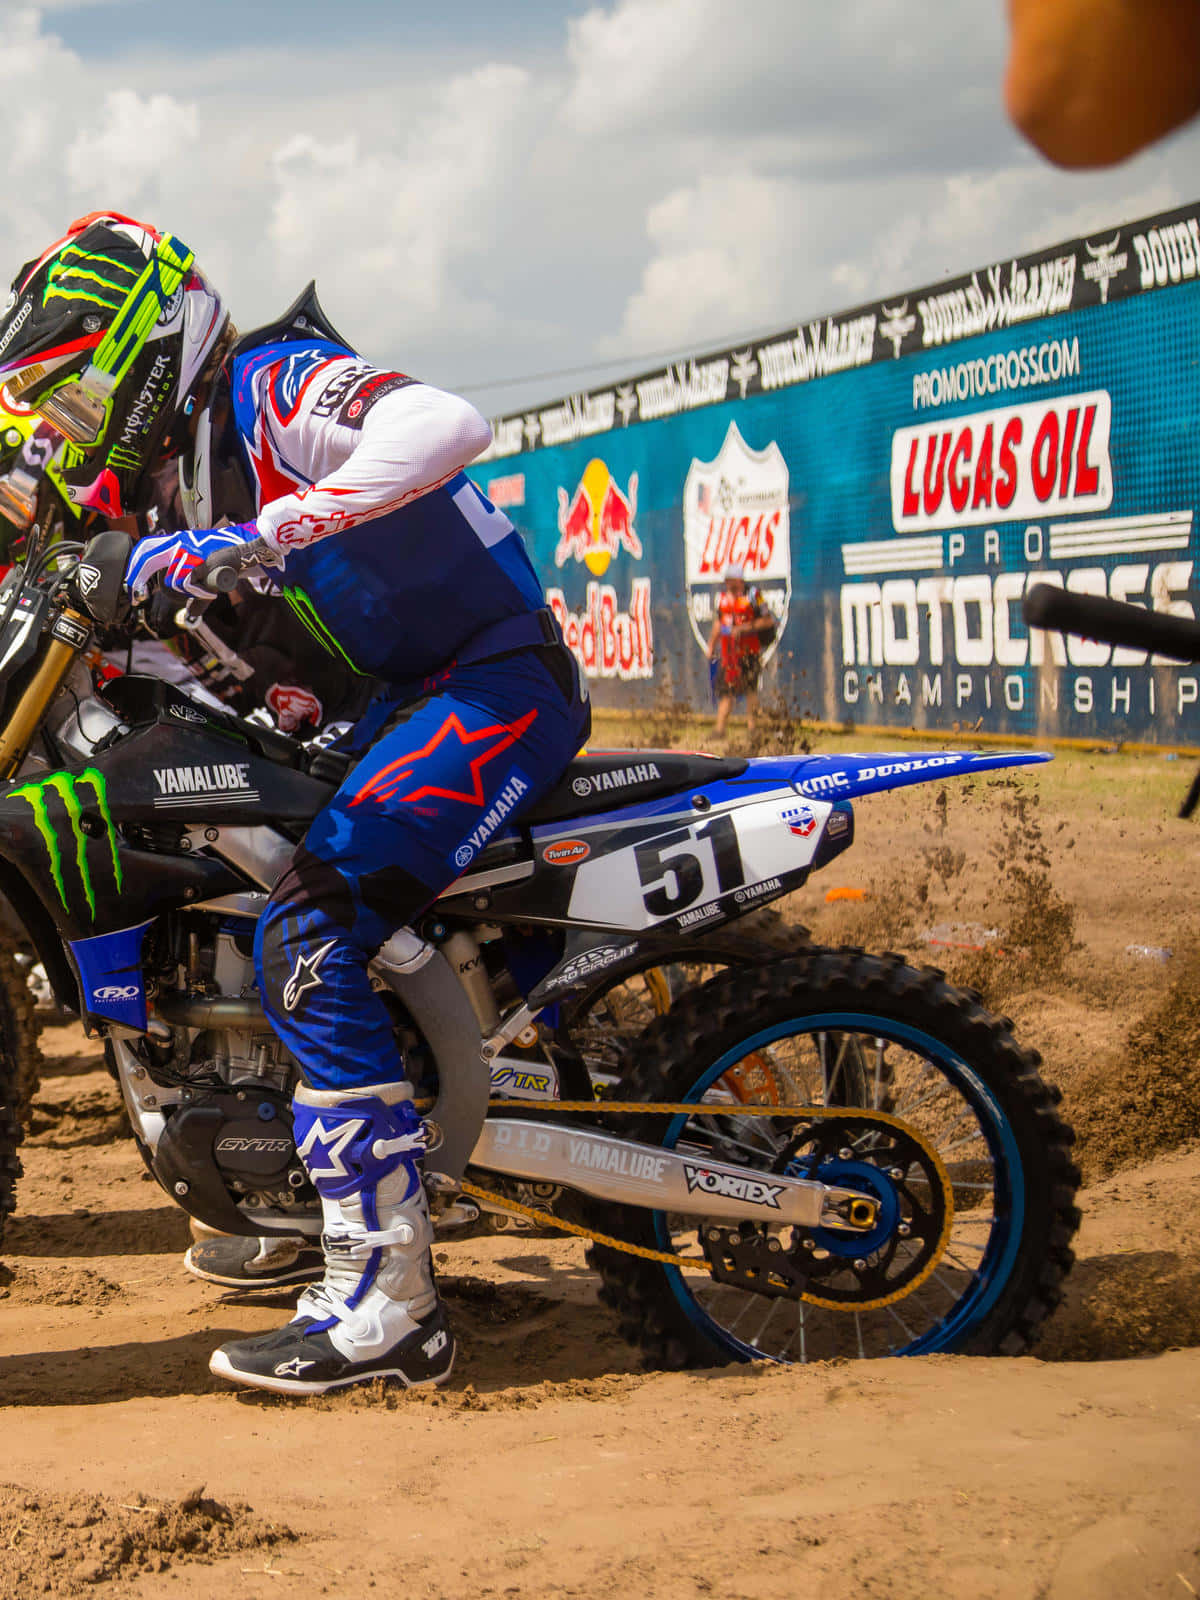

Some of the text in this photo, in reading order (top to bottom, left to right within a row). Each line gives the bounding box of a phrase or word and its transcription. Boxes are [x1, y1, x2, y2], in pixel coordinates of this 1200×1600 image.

[902, 404, 1100, 518] LUCAS OIL
[699, 510, 781, 573] LUCAS
[949, 525, 1043, 567] PRO
[600, 577, 652, 681] Bull
[843, 670, 1199, 715] CHAMPIONSHIP
[152, 763, 251, 795] YAMALUBE
[590, 762, 662, 792] YAMAHA
[857, 755, 963, 783] DUNLOP
[468, 776, 528, 849] YAMAHA
[634, 813, 746, 917] 51
[743, 877, 783, 900] YAMAHA
[676, 901, 722, 929] YAMALUBE
[216, 1137, 292, 1152] GYTR
[567, 1138, 666, 1183] YAMALUBE
[683, 1164, 788, 1209] VORTEX
